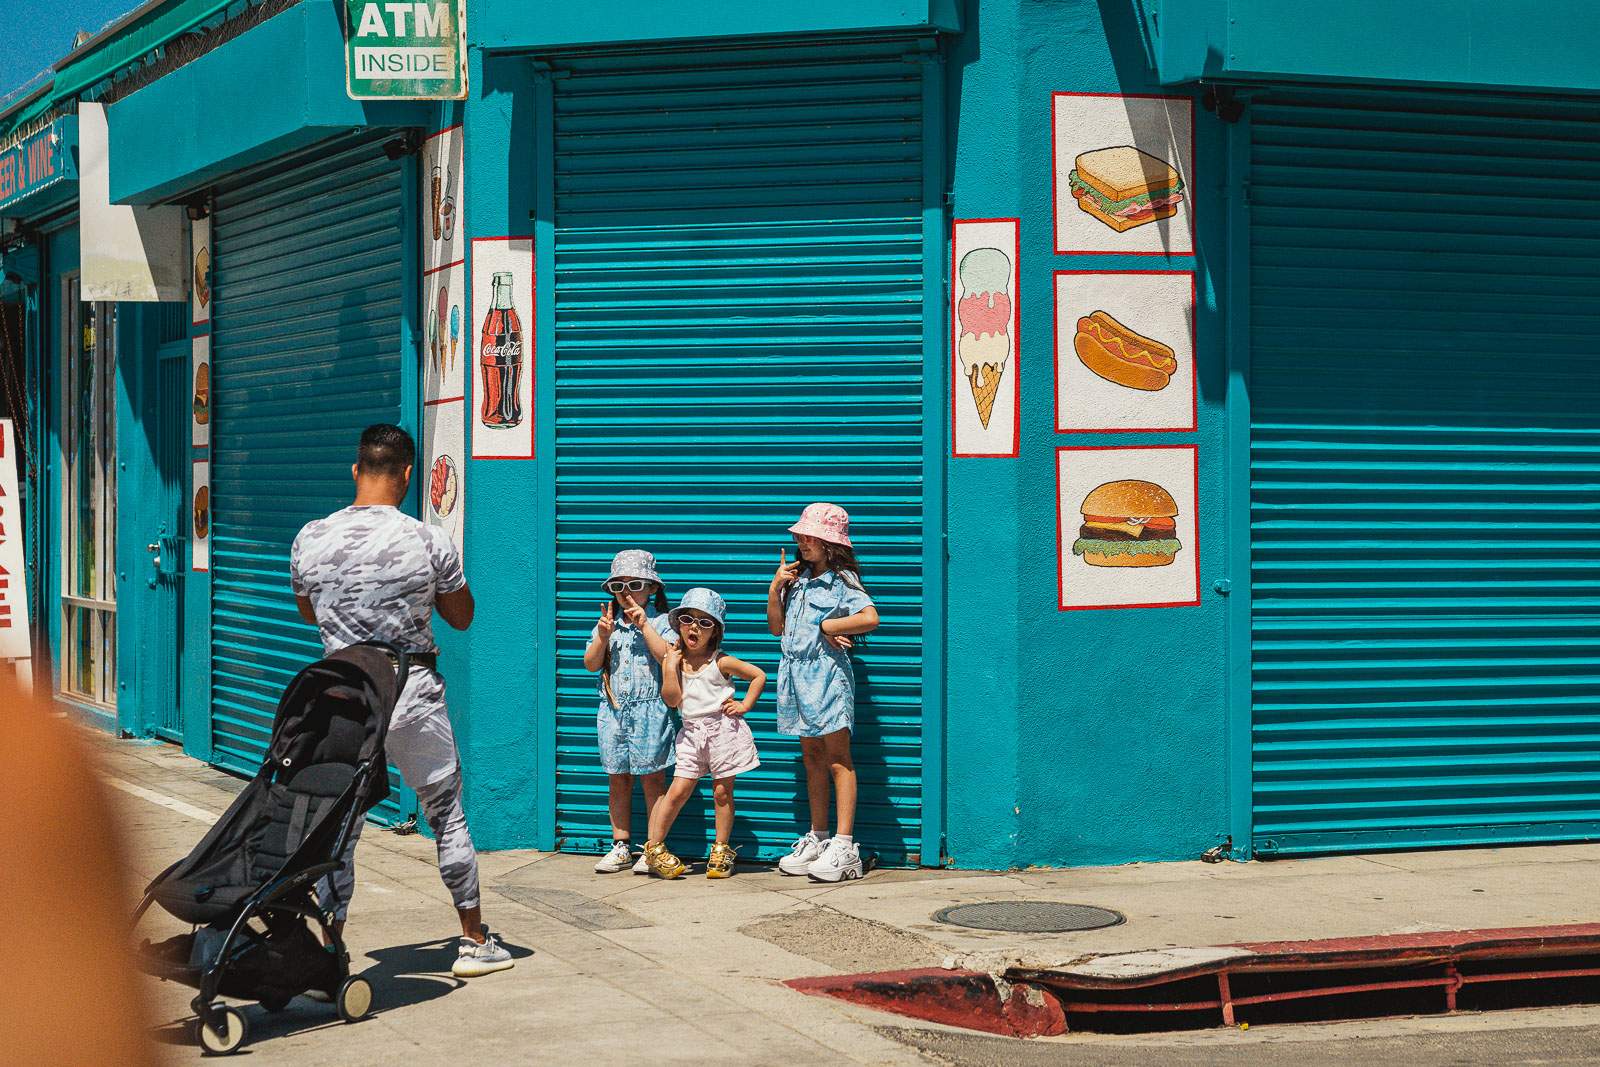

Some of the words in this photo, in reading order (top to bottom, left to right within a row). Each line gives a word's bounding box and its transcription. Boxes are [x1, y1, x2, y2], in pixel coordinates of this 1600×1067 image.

[357, 2, 451, 37] ATM
[361, 53, 449, 72] INSIDE
[18, 150, 26, 191] &
[28, 133, 55, 186] WINE
[483, 341, 523, 357] Coca-Cola
